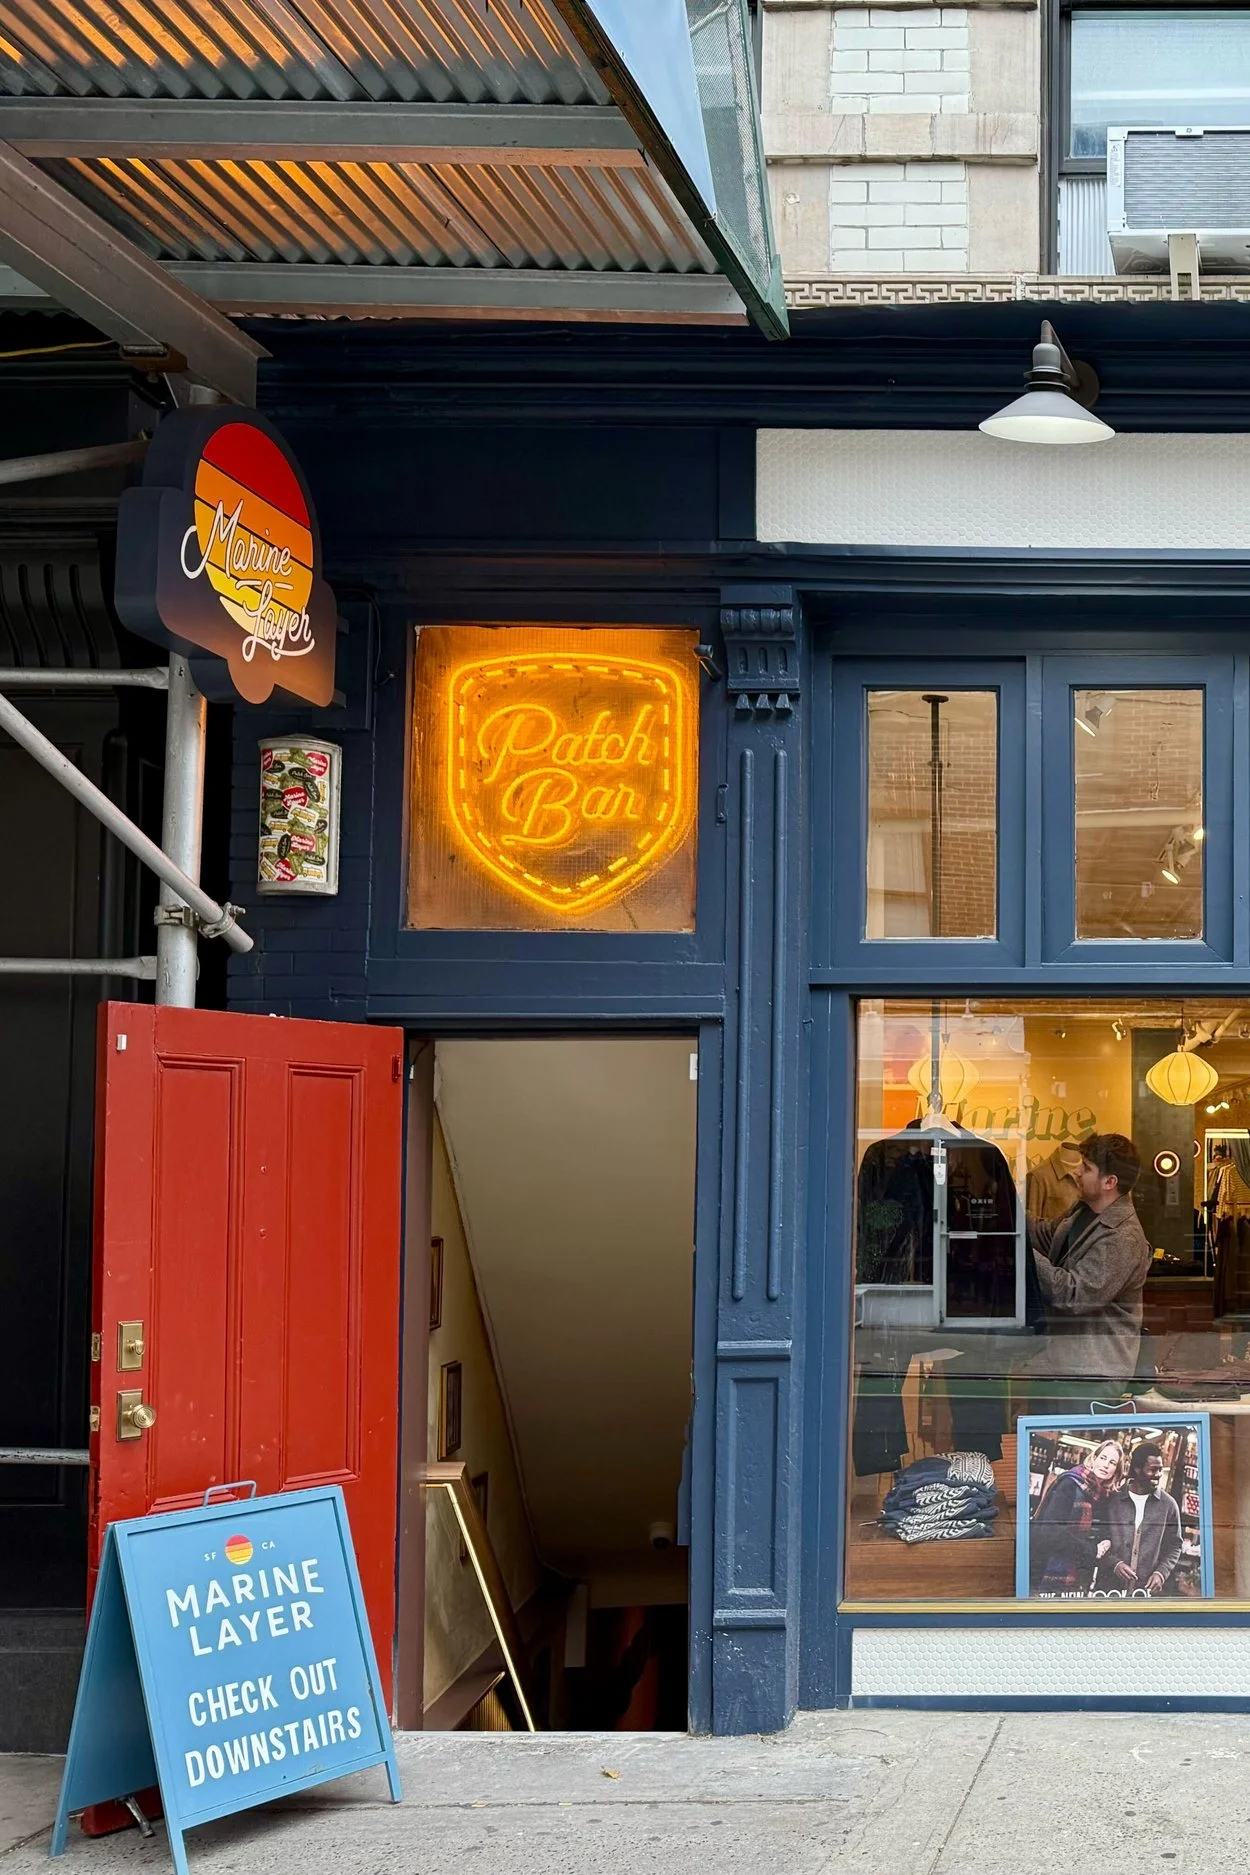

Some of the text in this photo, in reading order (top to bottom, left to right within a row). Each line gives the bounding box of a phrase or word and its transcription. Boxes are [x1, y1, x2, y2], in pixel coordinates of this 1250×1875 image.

[181, 499, 293, 580] Marine
[242, 579, 316, 662] Layer
[477, 703, 653, 784] Patch
[502, 767, 640, 846] Bar
[203, 1540, 276, 1562] SF CA
[165, 1557, 325, 1628] MARINE
[188, 1600, 315, 1657] LAYER
[188, 1657, 338, 1727] CHECK OUT
[184, 1705, 363, 1788] DOWNSTAIRS
